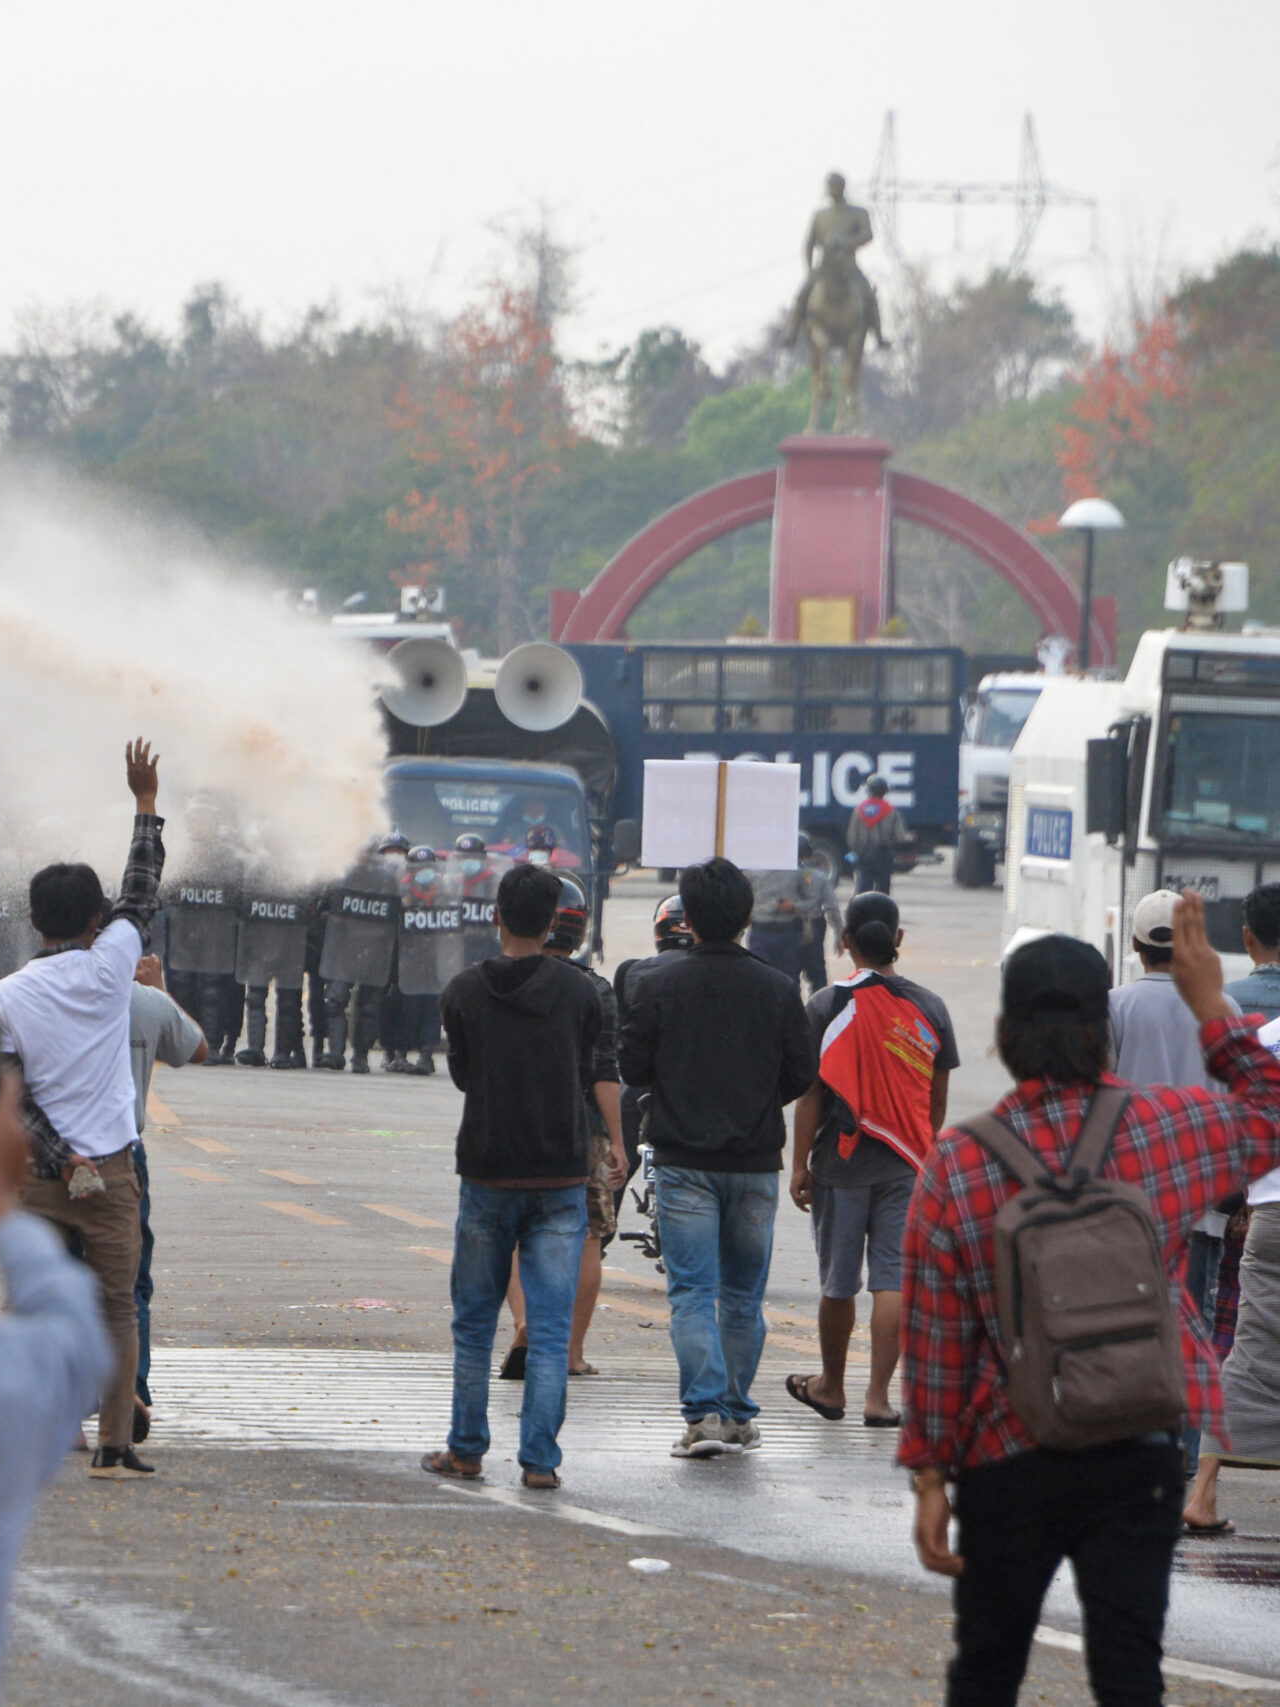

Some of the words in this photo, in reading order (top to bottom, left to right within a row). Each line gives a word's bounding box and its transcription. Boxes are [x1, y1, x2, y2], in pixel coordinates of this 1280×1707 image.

[683, 751, 916, 807] ICE
[1032, 813, 1068, 856] POLICE
[180, 887, 223, 905] POLICE
[251, 901, 296, 919] POLICE
[342, 896, 388, 917] POLICE
[462, 902, 495, 922] OLIC
[404, 910, 459, 930] POLICE
